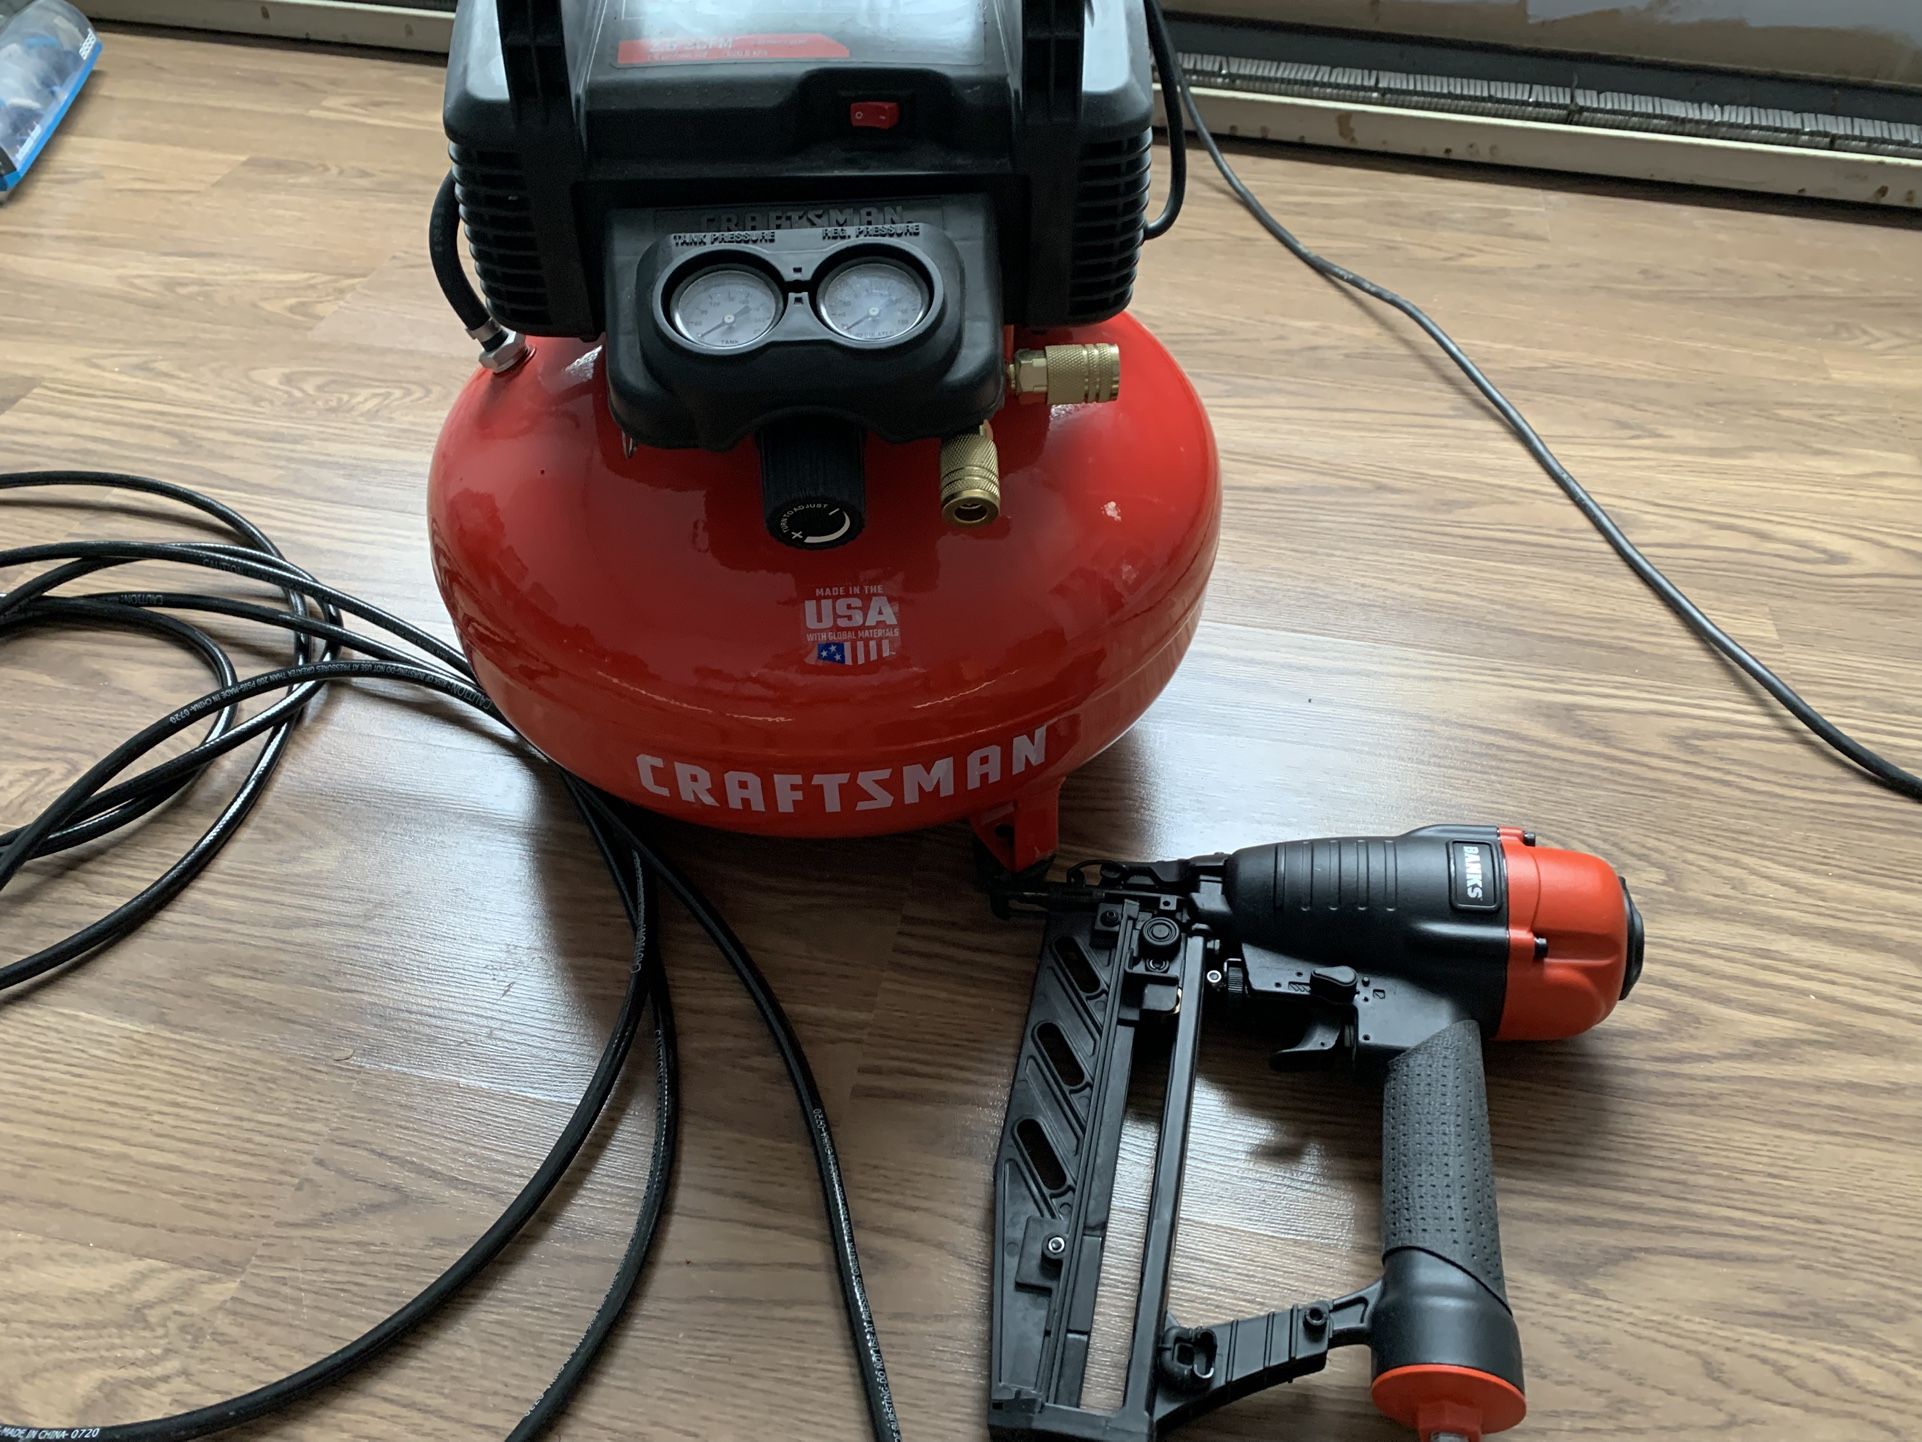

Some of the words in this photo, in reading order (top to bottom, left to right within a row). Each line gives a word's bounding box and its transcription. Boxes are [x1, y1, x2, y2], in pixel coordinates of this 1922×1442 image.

[700, 206, 904, 232] CRAFTSMAN
[673, 234, 706, 246] TANK
[710, 231, 776, 244] PRESSURE
[821, 228, 851, 240] REG.
[854, 224, 920, 238] PRESSURE
[793, 503, 829, 513] ADJUST
[815, 587, 846, 596] MADE
[849, 586, 860, 594] IN
[863, 585, 884, 593] THE
[804, 596, 898, 629] USA
[806, 631, 827, 642] WITH
[828, 630, 857, 640] GLOBAL
[858, 628, 900, 639] MATERIALS
[352, 663, 360, 672] AT
[360, 663, 372, 672] USE
[373, 664, 385, 672] NOT
[256, 676, 269, 686] 200
[268, 672, 286, 682] THAN
[212, 693, 220, 702] IN
[447, 682, 492, 710] CAUTION:
[169, 708, 190, 723] 0720
[635, 724, 1049, 814] CRAFTSMAN
[1463, 845, 1483, 899] BANKS
[812, 1107, 826, 1129] 0720
[851, 1276, 871, 1321] PRESSURES
[863, 1321, 875, 1333] AT
[866, 1334, 879, 1350] USE
[869, 1351, 884, 1370] NOT
[26, 1430, 37, 1439] IN
[71, 1428, 100, 1439] 0720
